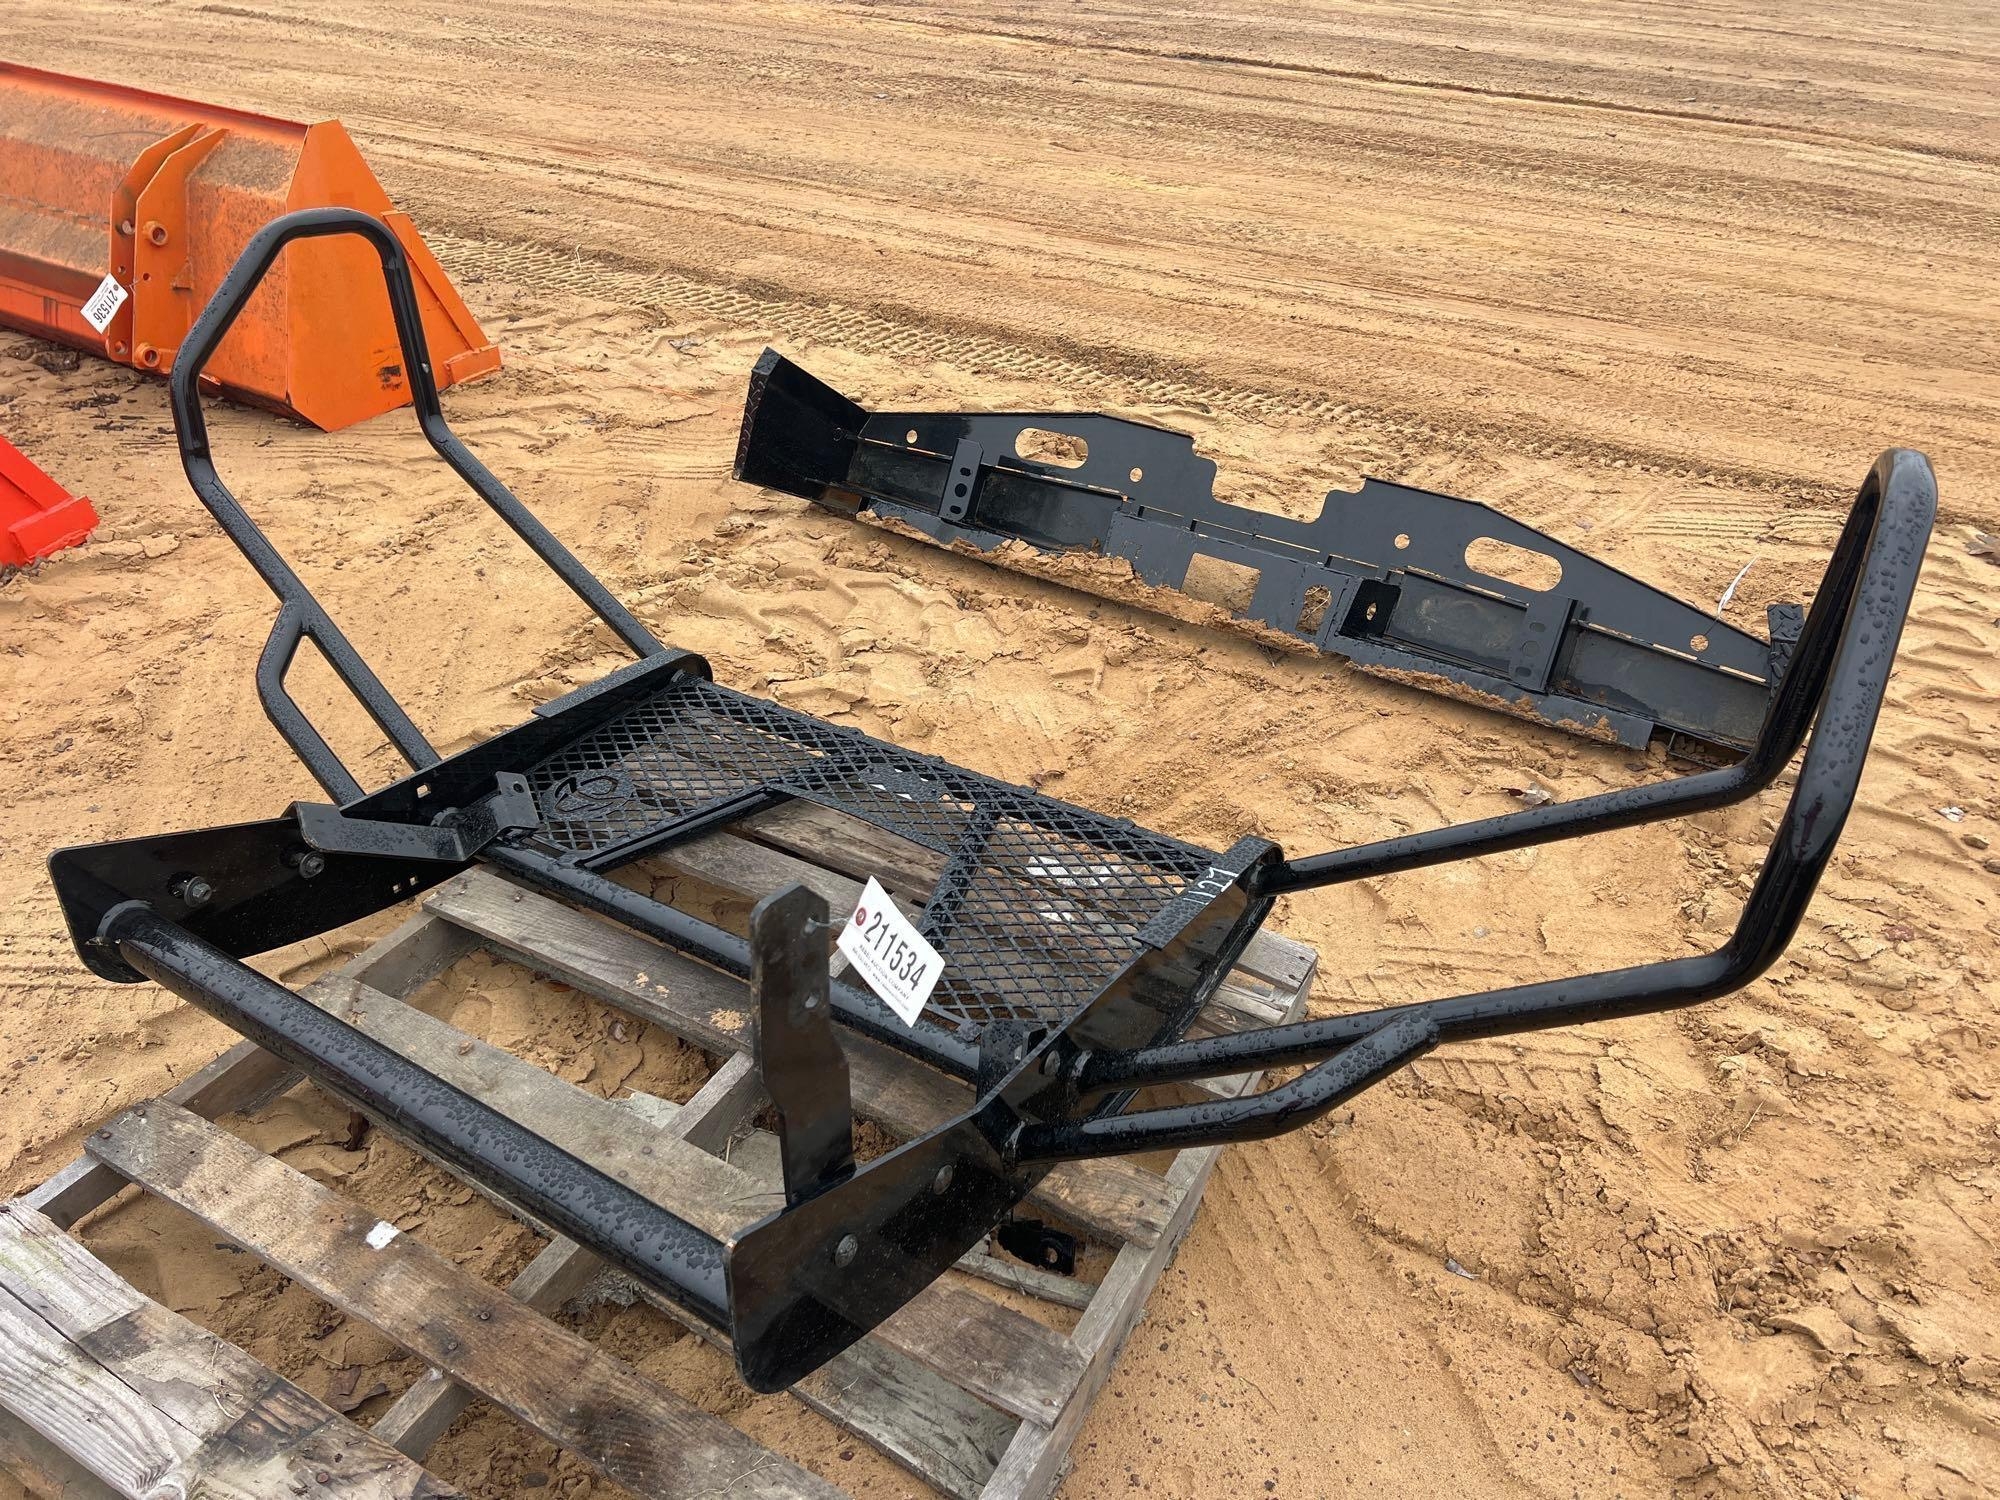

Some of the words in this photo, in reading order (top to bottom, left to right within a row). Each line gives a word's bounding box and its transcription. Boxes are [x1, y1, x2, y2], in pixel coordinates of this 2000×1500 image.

[93, 290, 118, 323] 211536
[1183, 867, 1240, 905] 1127
[863, 911, 927, 991] 211534
[888, 978, 910, 1000] COMPANY
